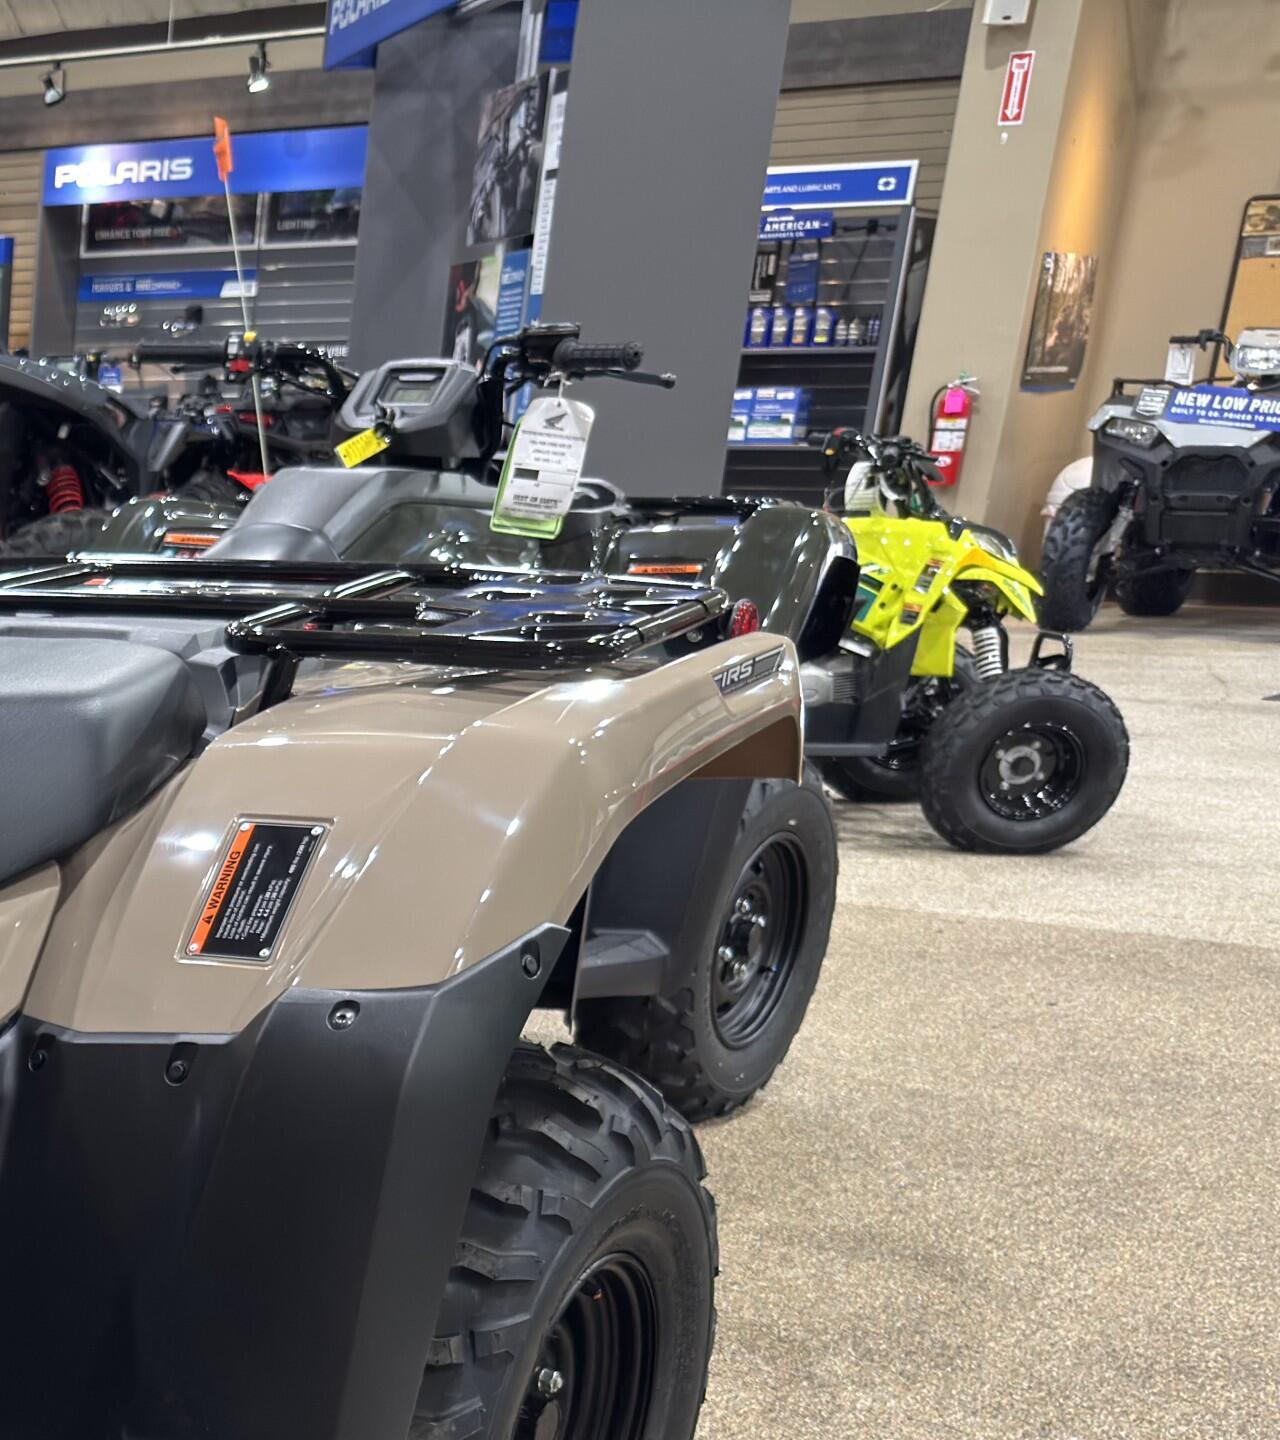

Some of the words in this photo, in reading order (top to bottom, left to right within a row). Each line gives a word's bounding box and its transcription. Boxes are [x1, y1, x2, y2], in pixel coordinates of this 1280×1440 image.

[54, 157, 193, 189] POLARIS
[764, 220, 821, 232] AMERICAN
[1174, 391, 1211, 407] NEW
[1212, 395, 1249, 412] LOW
[721, 659, 754, 689] IRS
[207, 850, 241, 912] WARNING
